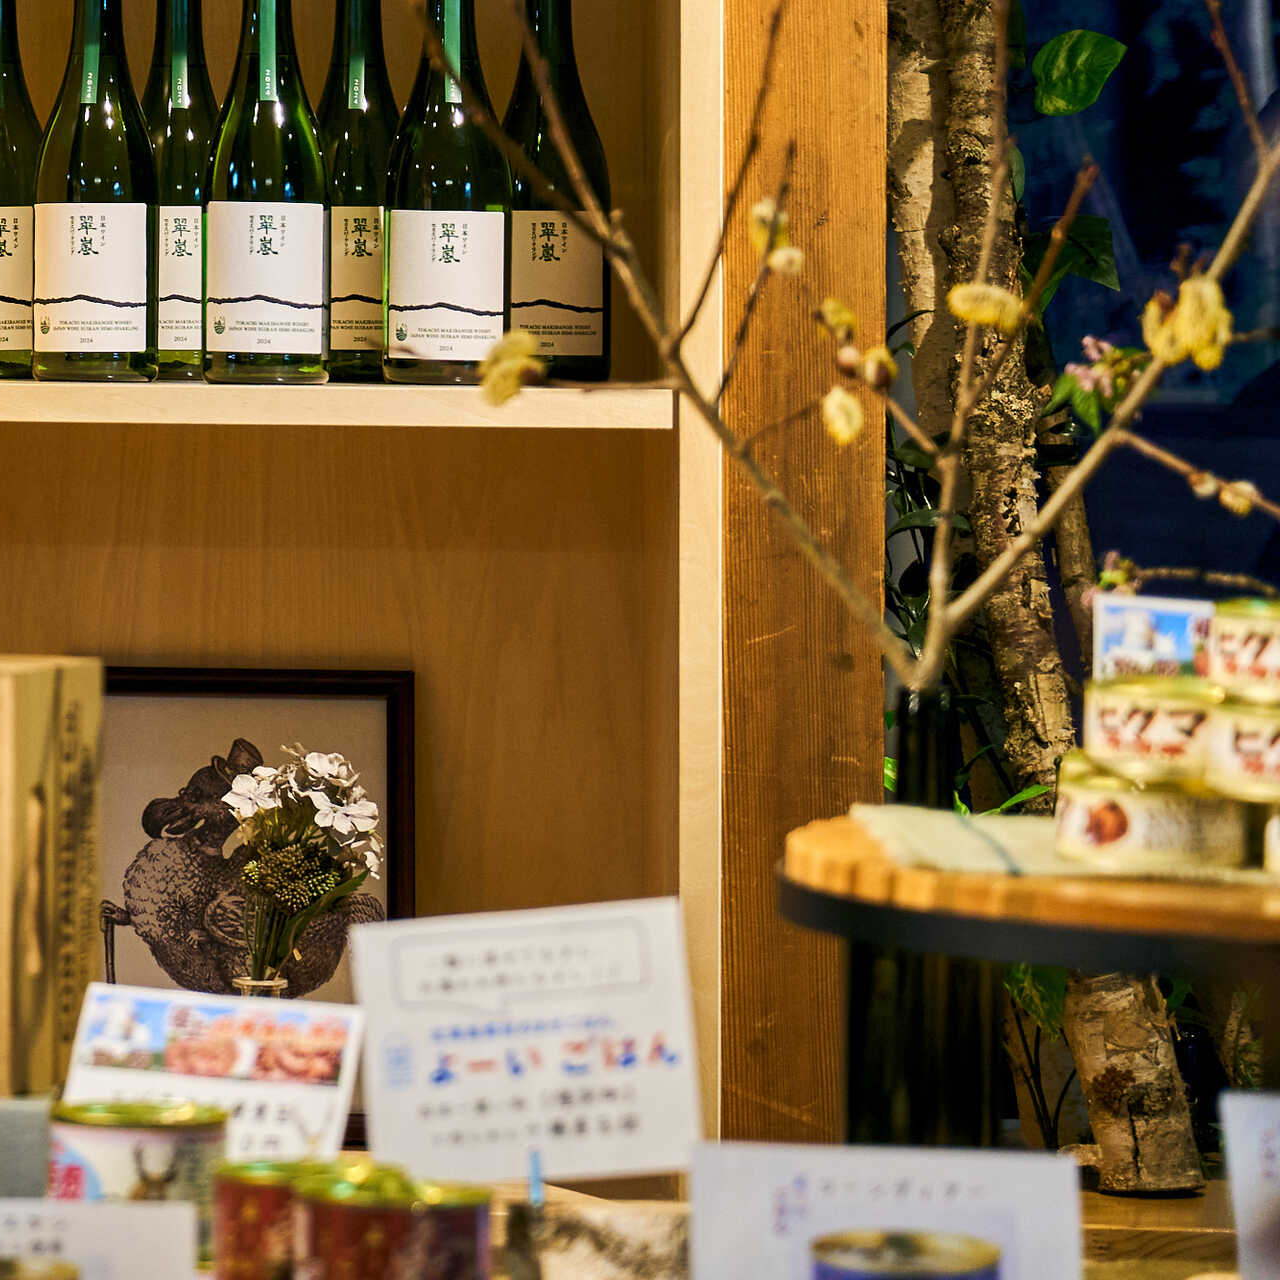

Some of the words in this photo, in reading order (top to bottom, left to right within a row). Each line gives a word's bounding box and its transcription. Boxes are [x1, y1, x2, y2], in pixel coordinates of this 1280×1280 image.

[78, 216, 99, 255] 翠嵐
[172, 218, 192, 257] 翠嵐
[256, 215, 278, 255] 翠嵐
[351, 218, 373, 257] 翠嵐
[439, 223, 460, 263] 翠嵐
[538, 222, 559, 262] 翠嵐
